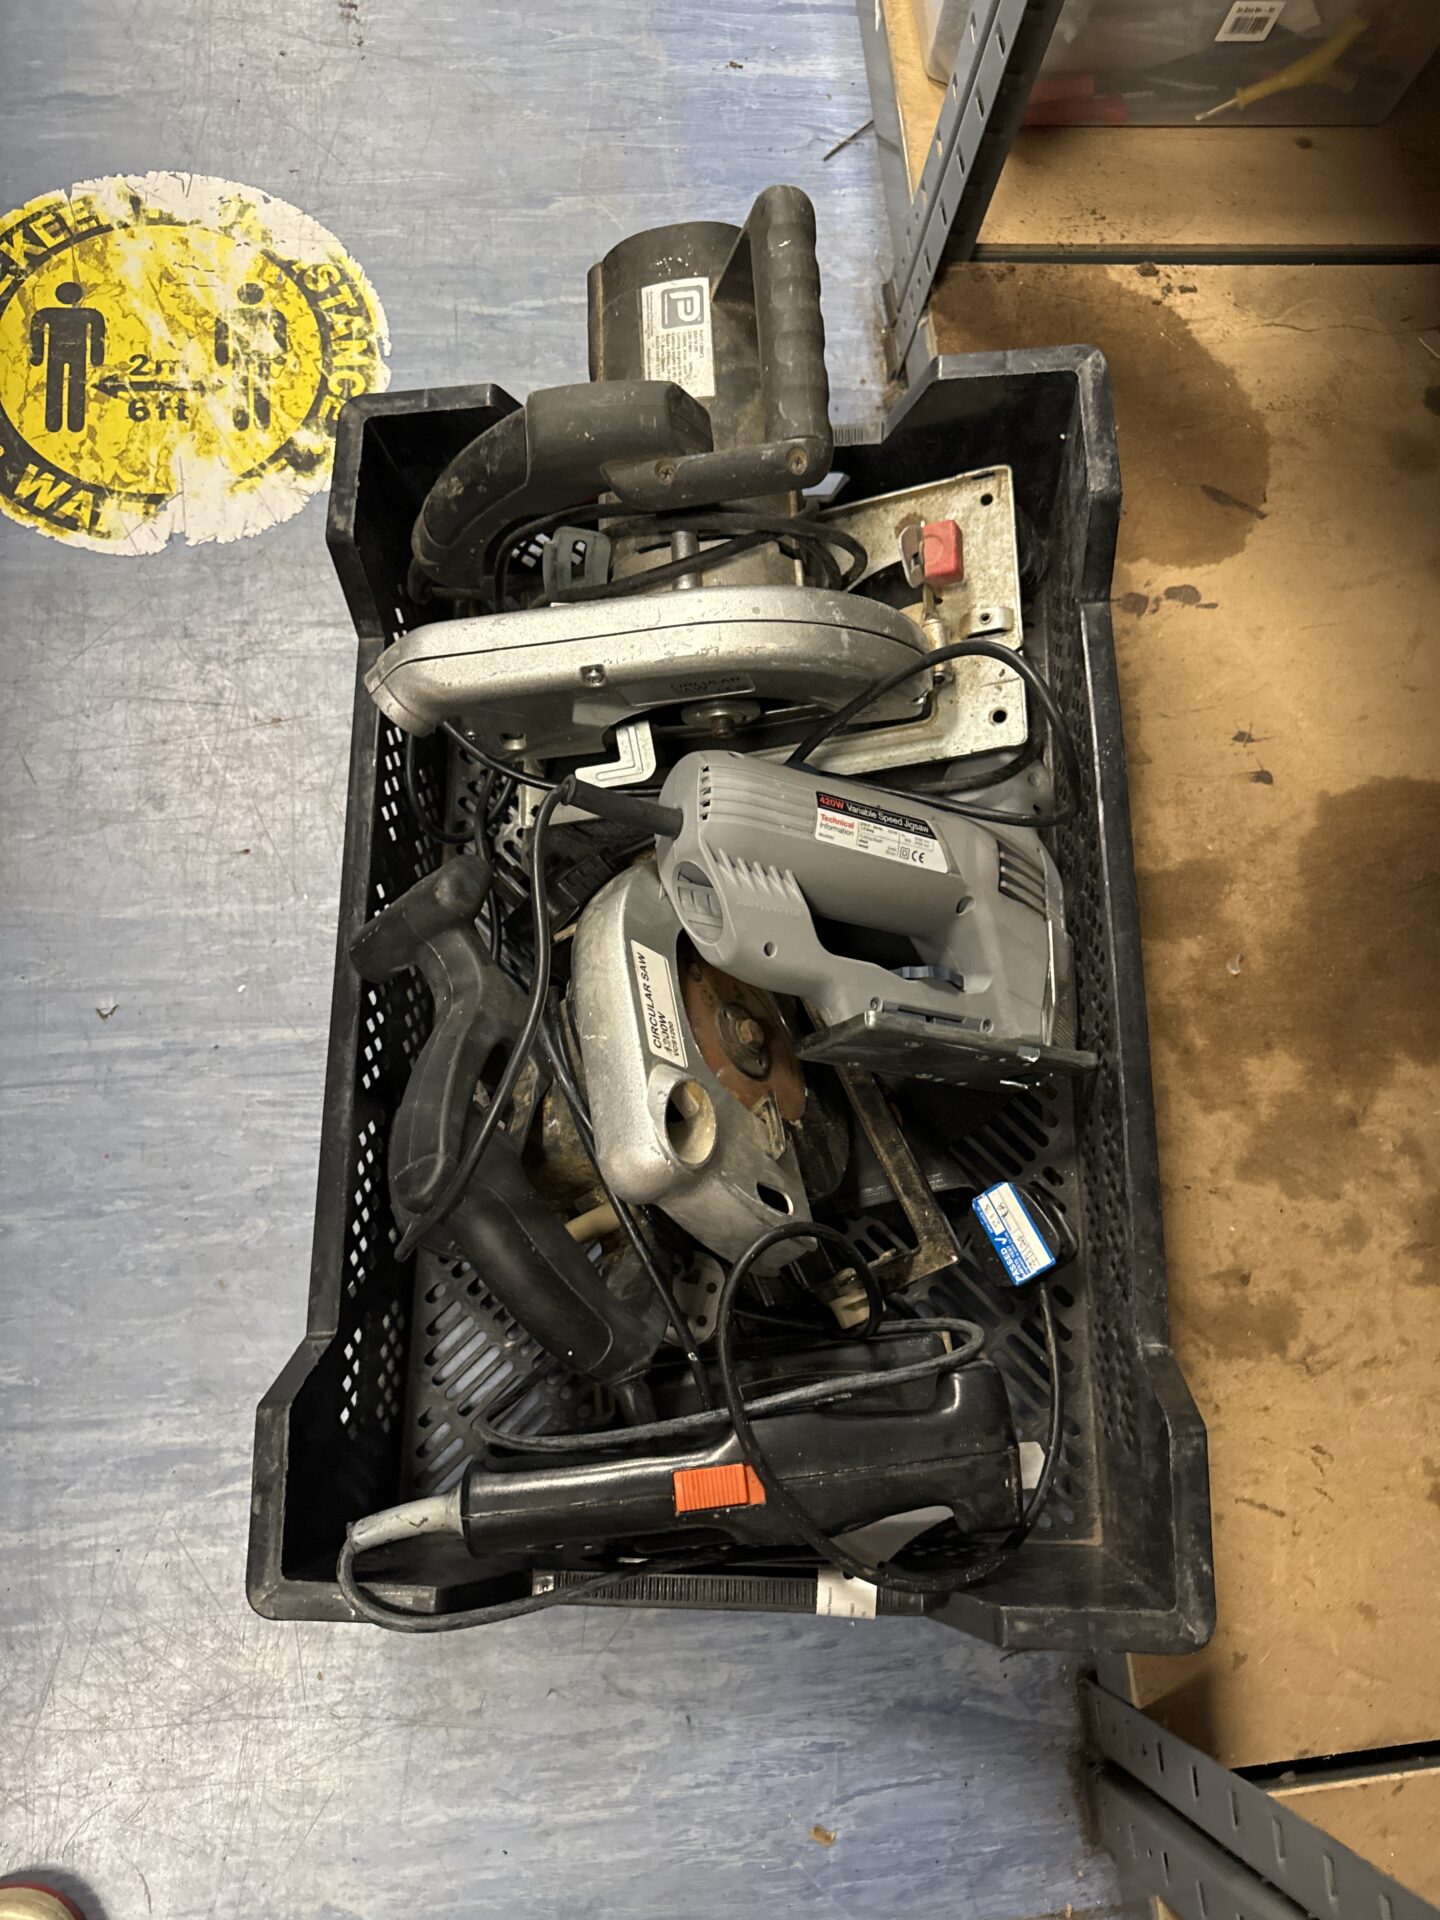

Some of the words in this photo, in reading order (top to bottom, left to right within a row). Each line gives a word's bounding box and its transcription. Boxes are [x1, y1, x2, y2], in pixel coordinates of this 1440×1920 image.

[0, 200, 104, 270] KEE
[292, 263, 367, 421] STANCE
[128, 398, 189, 423] 6ft
[819, 796, 845, 809] 420W
[846, 803, 877, 819] Variable
[878, 813, 903, 826] Speed
[903, 821, 929, 834] Jigsaw
[819, 822, 854, 836] Information
[820, 814, 855, 828] Technical
[636, 951, 649, 981] SAW
[642, 983, 663, 1049] CIRCULAR
[999, 1246, 1022, 1282] PASSED
